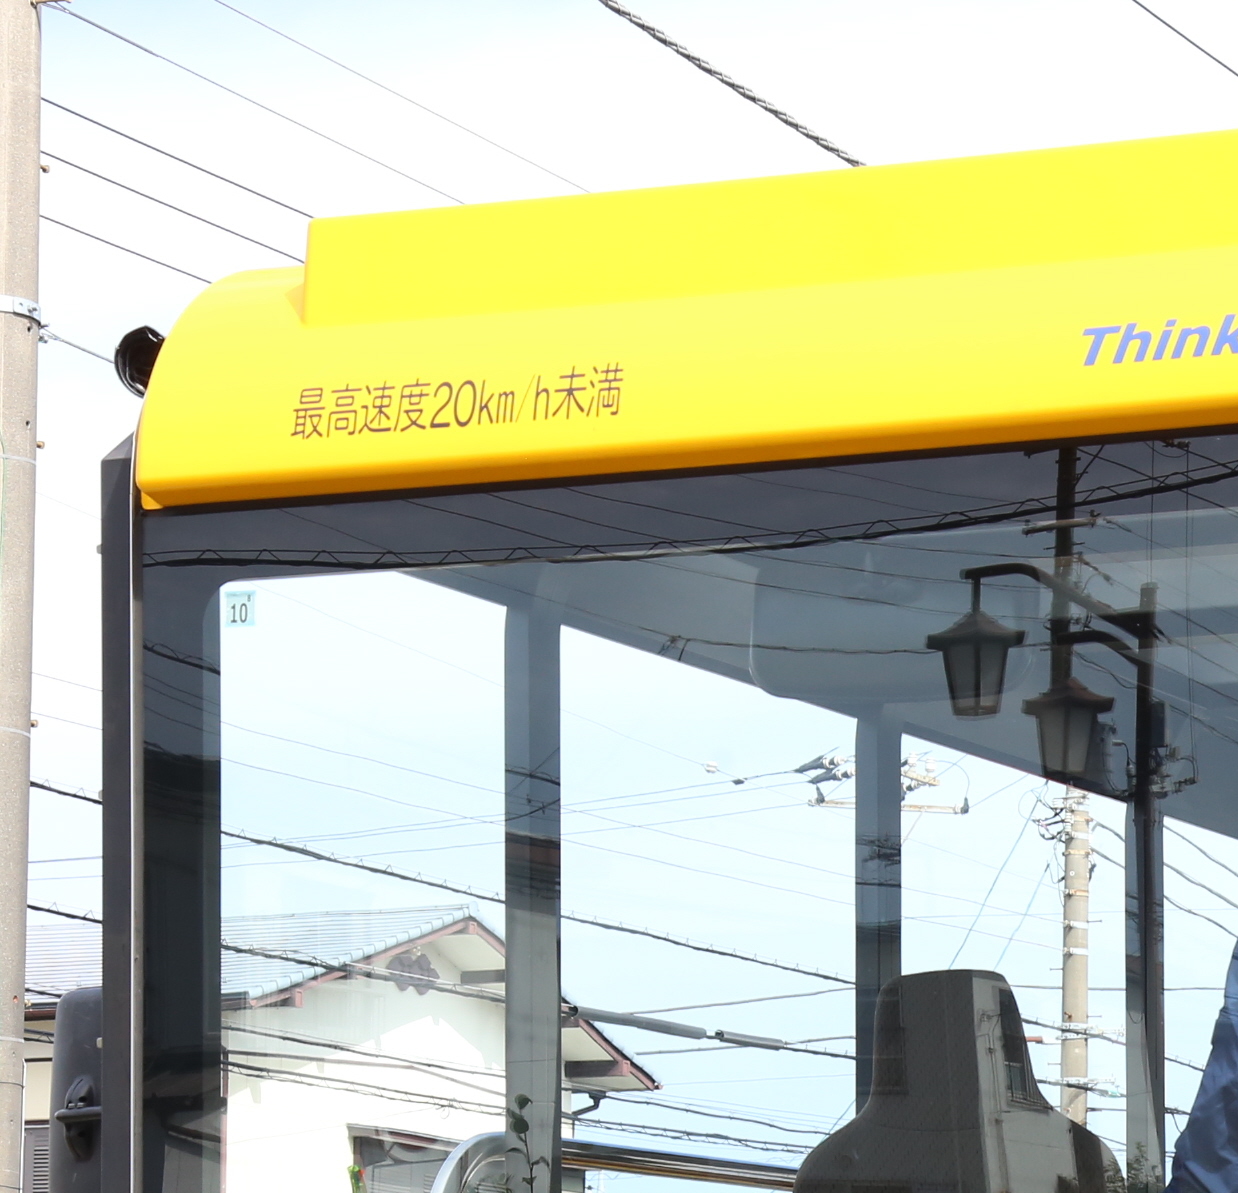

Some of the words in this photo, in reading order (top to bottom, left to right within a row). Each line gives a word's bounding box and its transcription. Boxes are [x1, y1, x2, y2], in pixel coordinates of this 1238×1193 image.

[290, 362, 625, 440] 最高速度20km/h未満
[230, 603, 248, 623] 10
